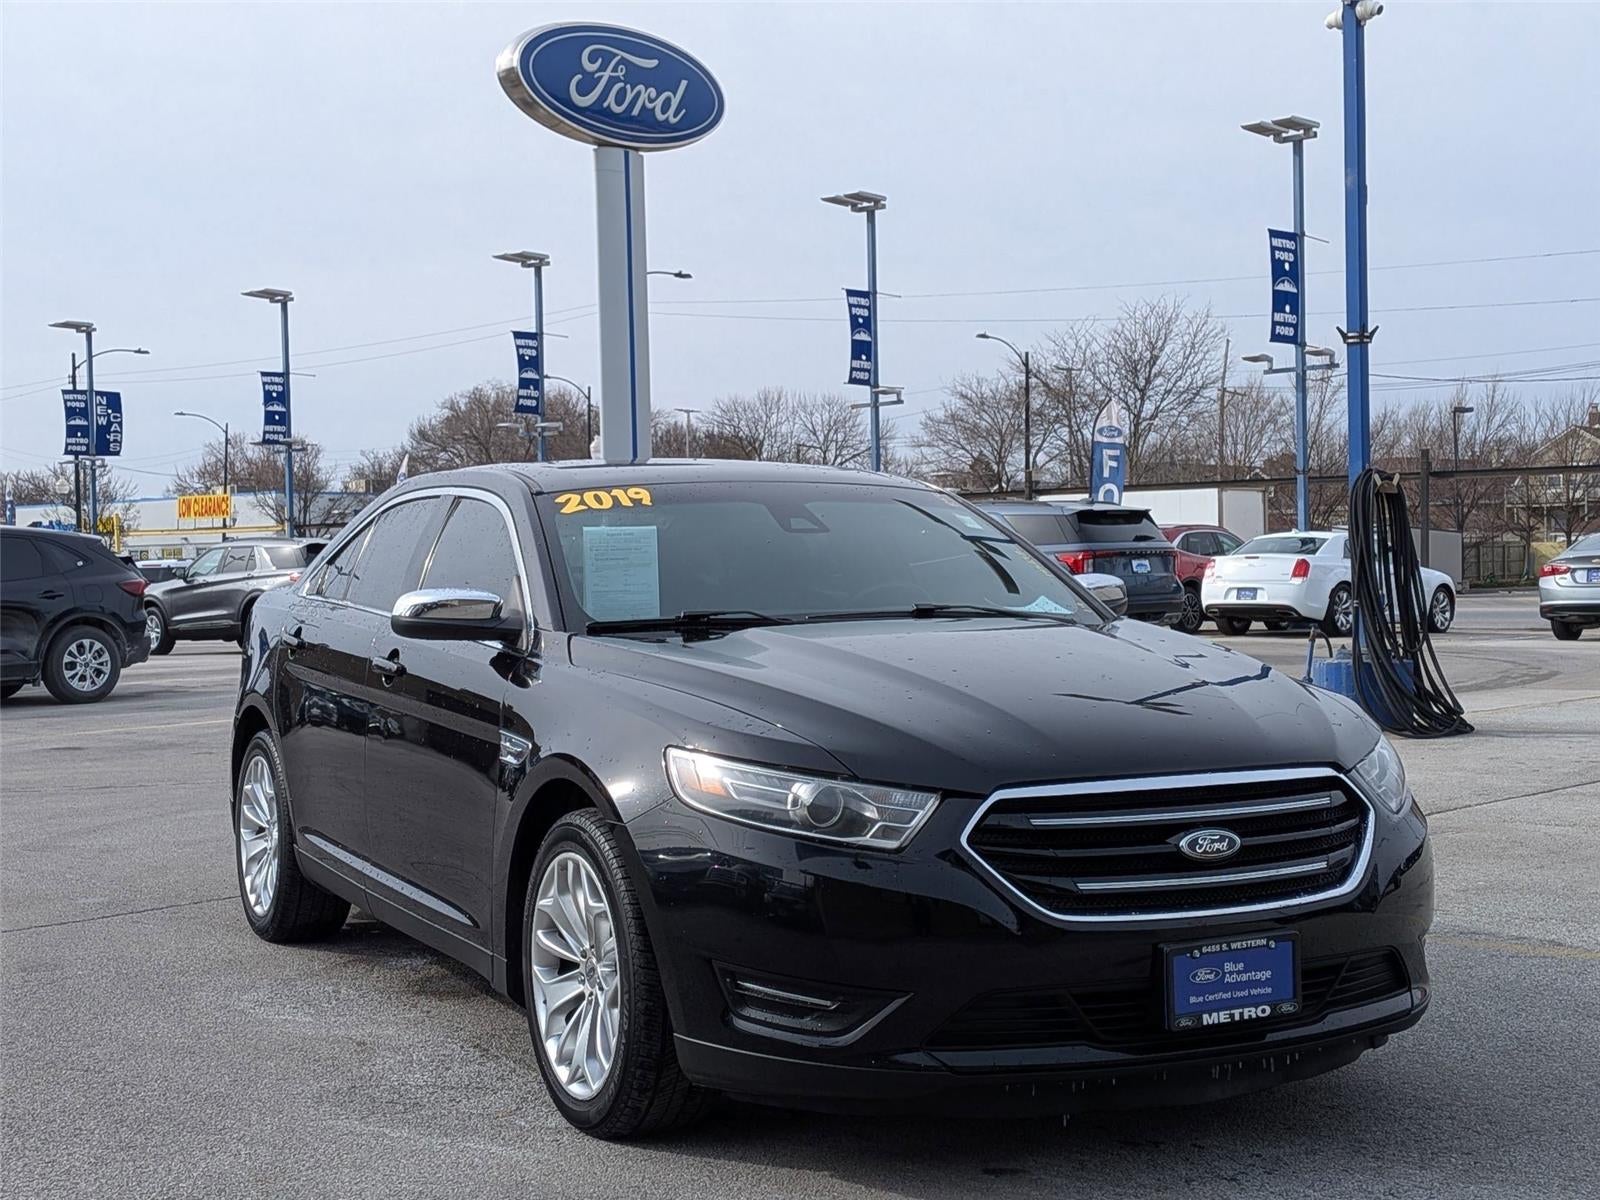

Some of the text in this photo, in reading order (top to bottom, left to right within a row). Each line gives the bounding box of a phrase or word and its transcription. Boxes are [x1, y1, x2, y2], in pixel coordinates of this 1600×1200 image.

[569, 44, 688, 124] Ford
[1271, 237, 1296, 250] METRO
[1275, 250, 1295, 262] FORD
[848, 296, 870, 307] METRO
[851, 306, 869, 317] FORD
[1273, 312, 1298, 324] METRO
[1275, 325, 1295, 337] FORD
[515, 338, 538, 347] METRO
[518, 348, 537, 356] FORD
[851, 359, 872, 370] METRO
[262, 376, 284, 384] METRO
[851, 370, 870, 380] FORD
[264, 384, 284, 392] FORD
[518, 388, 540, 398] METRO
[518, 398, 537, 407] FORD
[96, 395, 108, 426] NEW
[109, 412, 122, 452] CARS
[264, 425, 287, 433] METRO
[265, 433, 284, 441] FORD
[67, 444, 87, 452] FORD
[178, 496, 229, 518] LOW CLEARANCE
[553, 487, 653, 515] 2019
[1195, 835, 1229, 853] Ford
[1230, 938, 1267, 950] WESTERN
[1224, 962, 1244, 972] Blue
[1195, 969, 1216, 981] Ford
[1224, 969, 1272, 984] Advantage
[1189, 986, 1273, 1004] Blue Certified Used Vehicle
[1202, 1005, 1271, 1025] METRO
